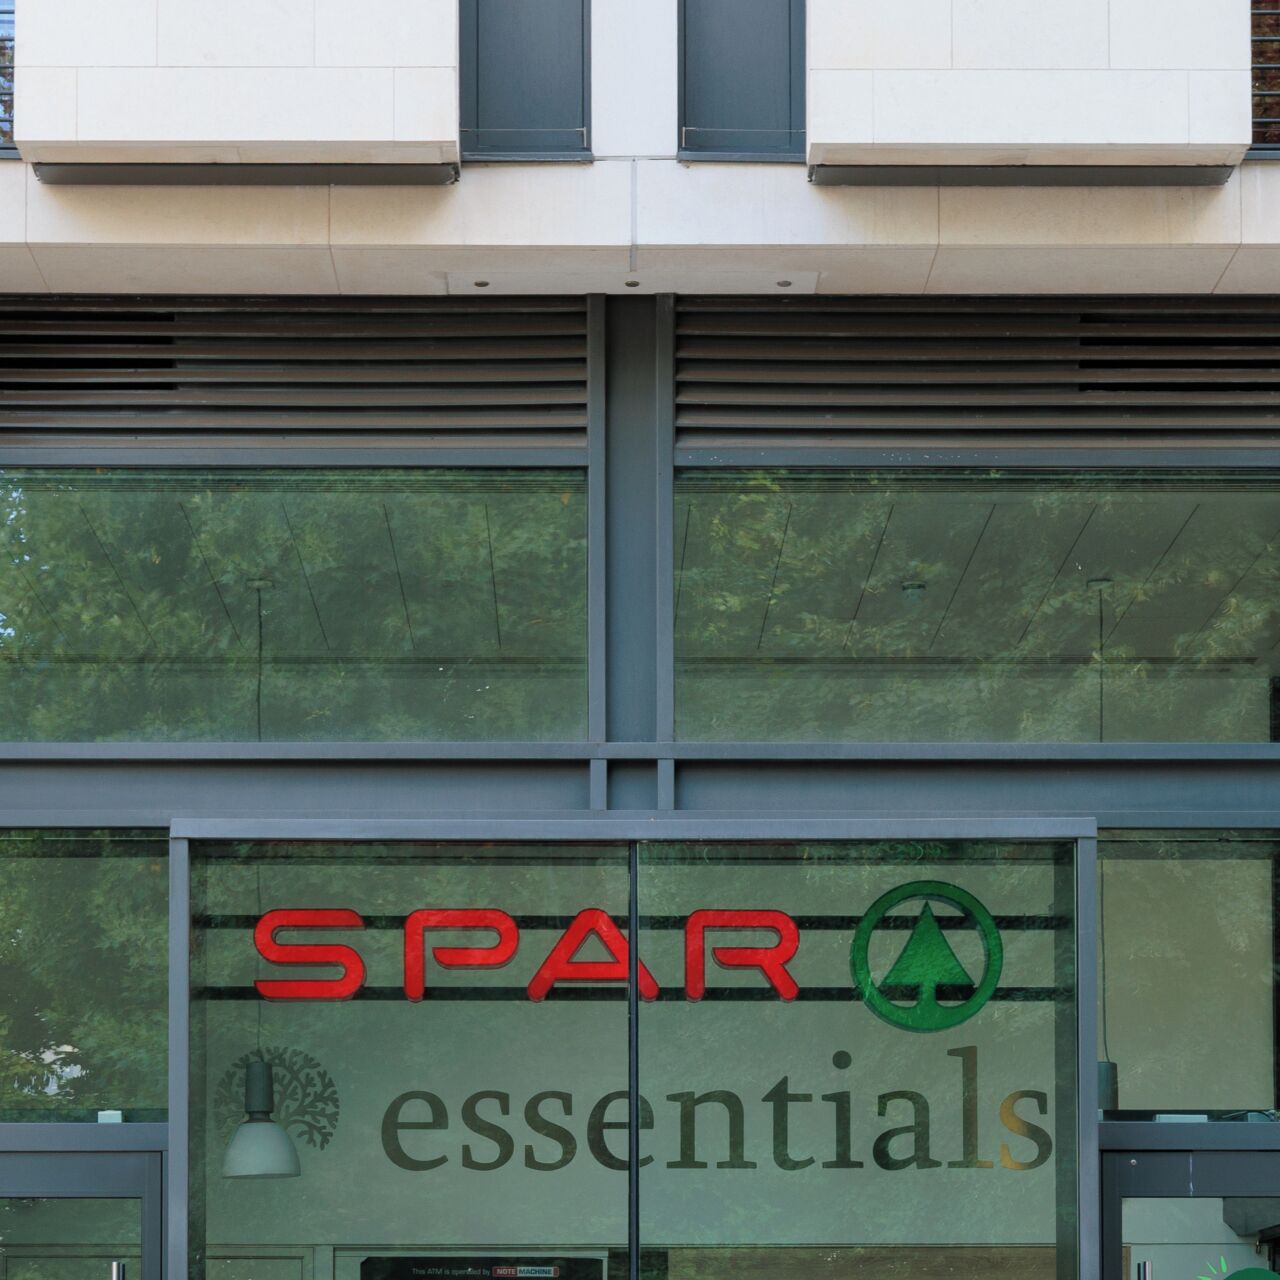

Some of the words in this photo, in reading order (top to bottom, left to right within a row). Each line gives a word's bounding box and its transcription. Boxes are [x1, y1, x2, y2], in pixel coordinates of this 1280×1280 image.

[253, 907, 800, 1001] SPAR
[380, 1045, 1054, 1172] essentials
[496, 1268, 516, 1276] NOTE
[519, 1268, 553, 1276] MACHINE
